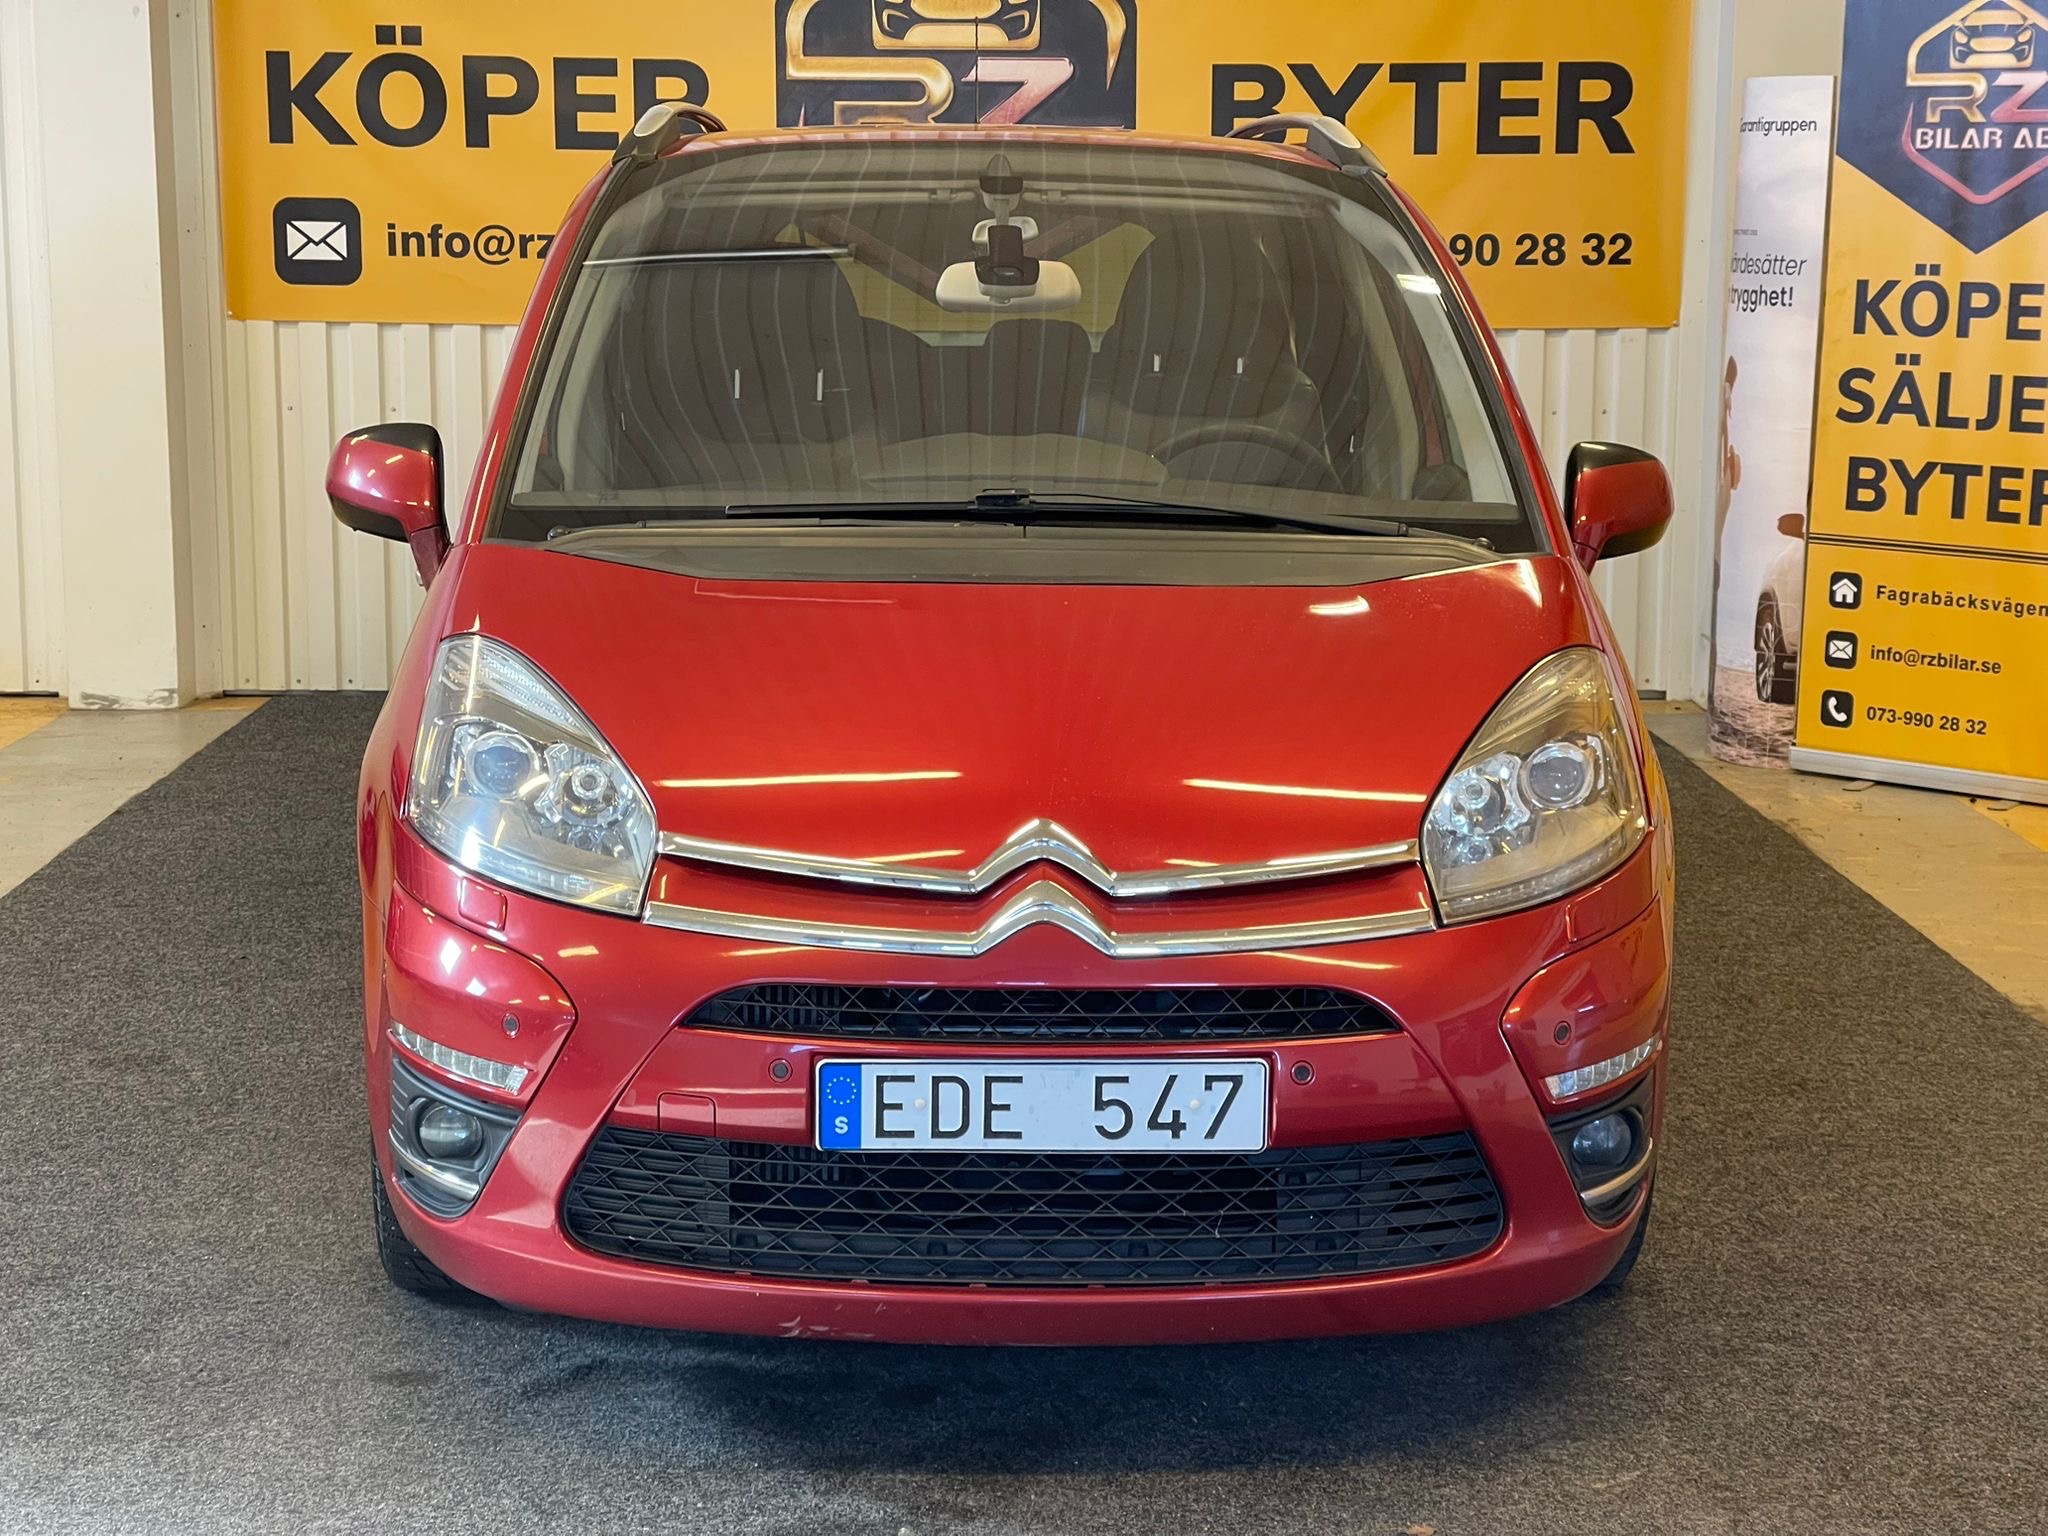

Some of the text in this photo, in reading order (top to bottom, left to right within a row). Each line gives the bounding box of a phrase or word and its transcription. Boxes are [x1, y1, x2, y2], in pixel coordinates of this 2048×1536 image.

[1211, 61, 1636, 155] BYTER
[1916, 127, 2003, 149] BILAR
[387, 222, 556, 266] info@rz
[1448, 232, 1633, 267] 90 28 32
[1731, 252, 1808, 277] ärdesätter
[1876, 585, 2048, 619] Fagrabäcksvägen
[1870, 644, 2002, 675] info@rzbilar.se
[1866, 706, 1988, 736] 073-990 28 32
[875, 1074, 1244, 1141] EDE 547
[834, 1115, 849, 1135] S
